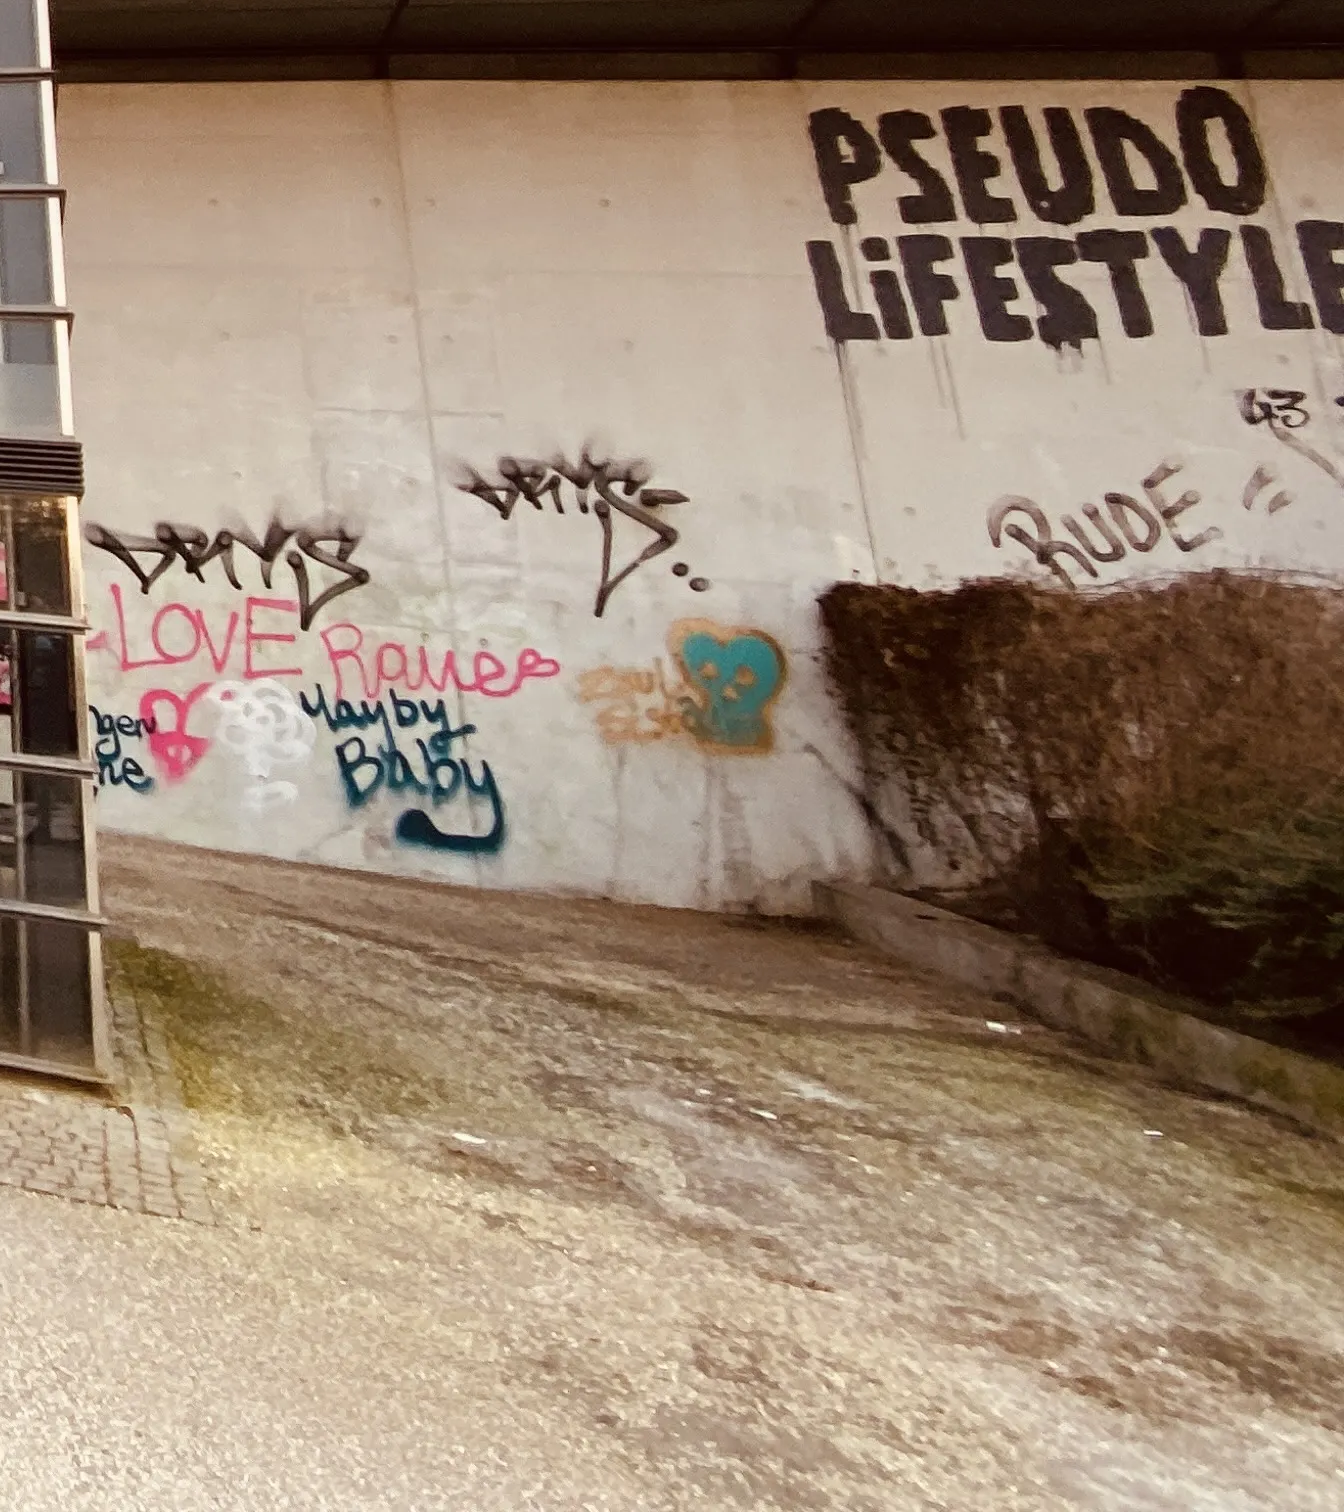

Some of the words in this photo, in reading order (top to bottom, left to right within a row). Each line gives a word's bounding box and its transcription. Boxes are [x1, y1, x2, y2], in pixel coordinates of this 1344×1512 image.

[808, 85, 1267, 226] PSEUDO
[987, 461, 1224, 590] RUDE
[109, 583, 302, 679] LOVE
[334, 736, 505, 855] Baby
